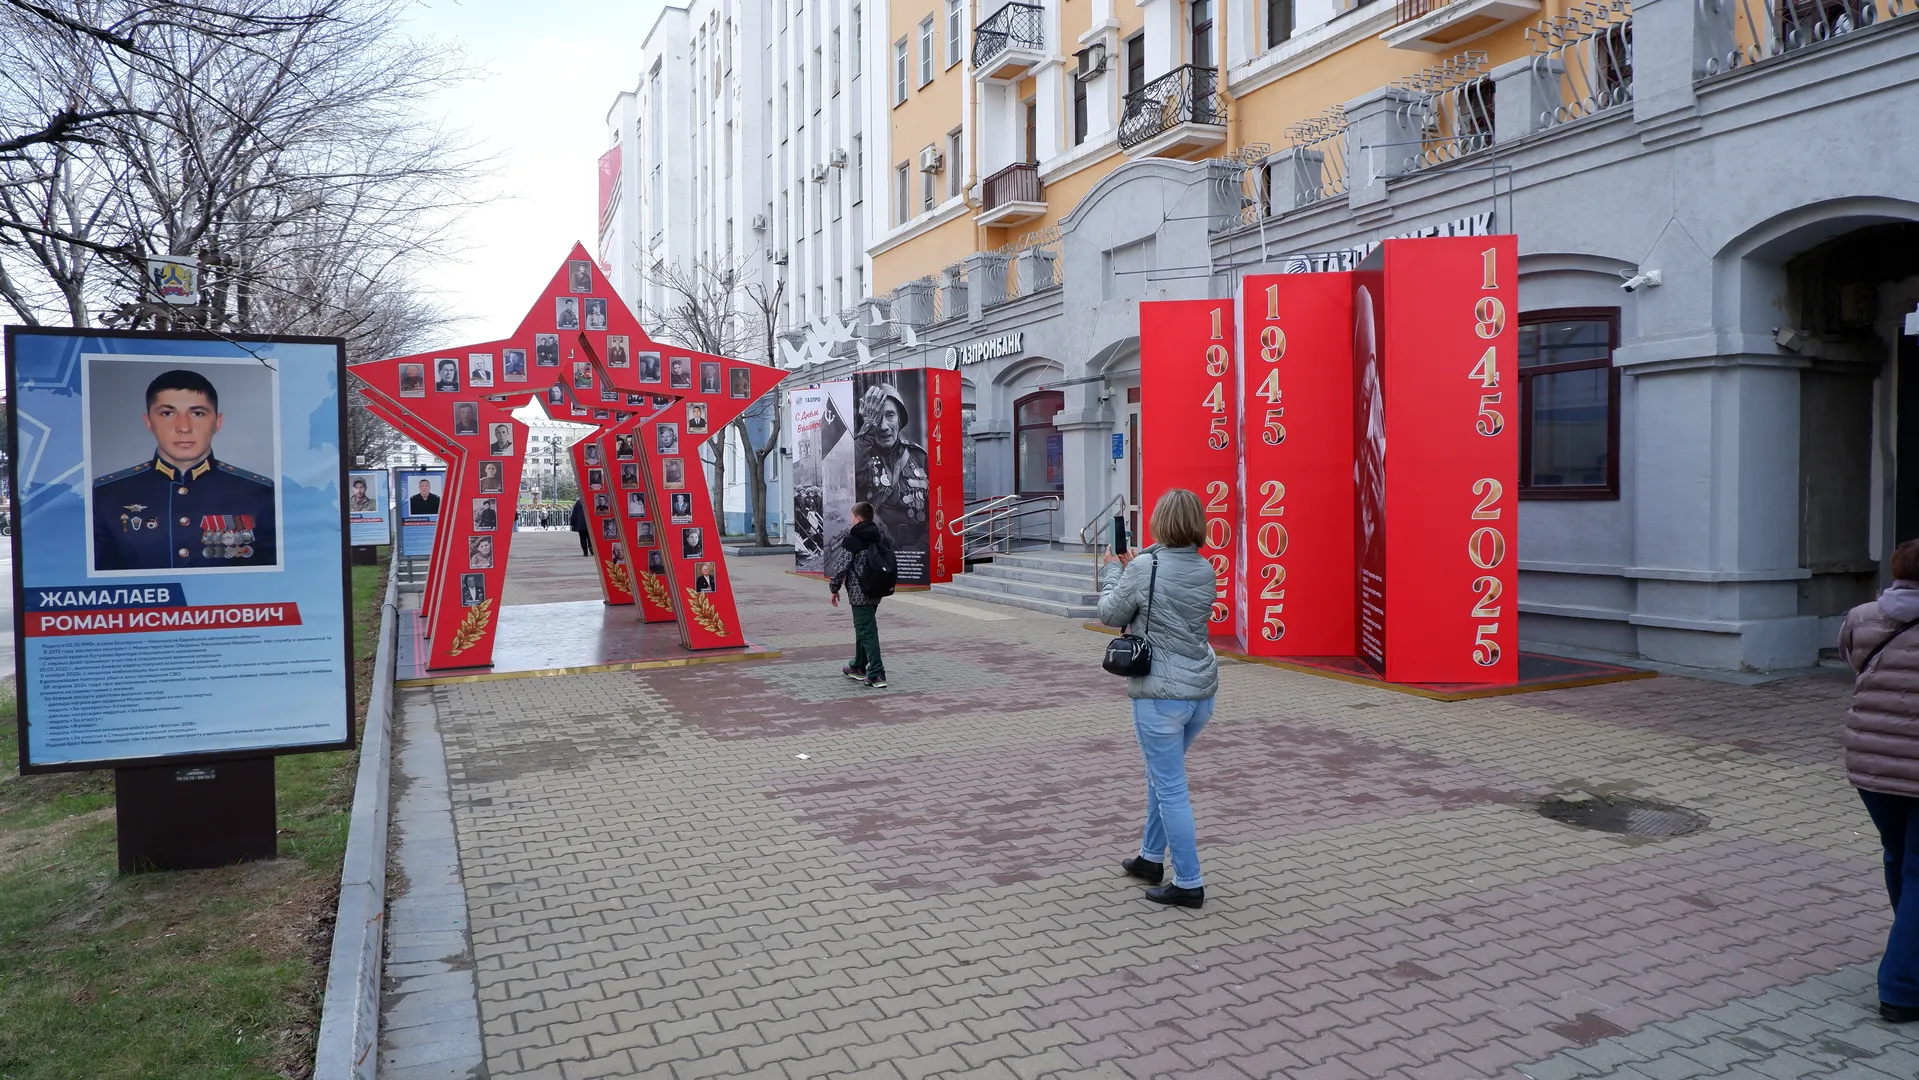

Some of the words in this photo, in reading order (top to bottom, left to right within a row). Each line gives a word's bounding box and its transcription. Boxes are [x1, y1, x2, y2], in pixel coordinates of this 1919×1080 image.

[1202, 307, 1230, 450] 1945
[1255, 283, 1287, 446] 1945
[1468, 247, 1506, 437] 1945
[932, 373, 943, 465] 1941
[39, 588, 171, 607] ЖАМАЛАЕВ
[934, 485, 945, 577] 1945
[1257, 480, 1289, 641] 2025
[1468, 478, 1506, 667] 2025
[41, 613, 124, 632] РОМАН
[129, 606, 284, 629] ИСМАИЛОВИЧ
